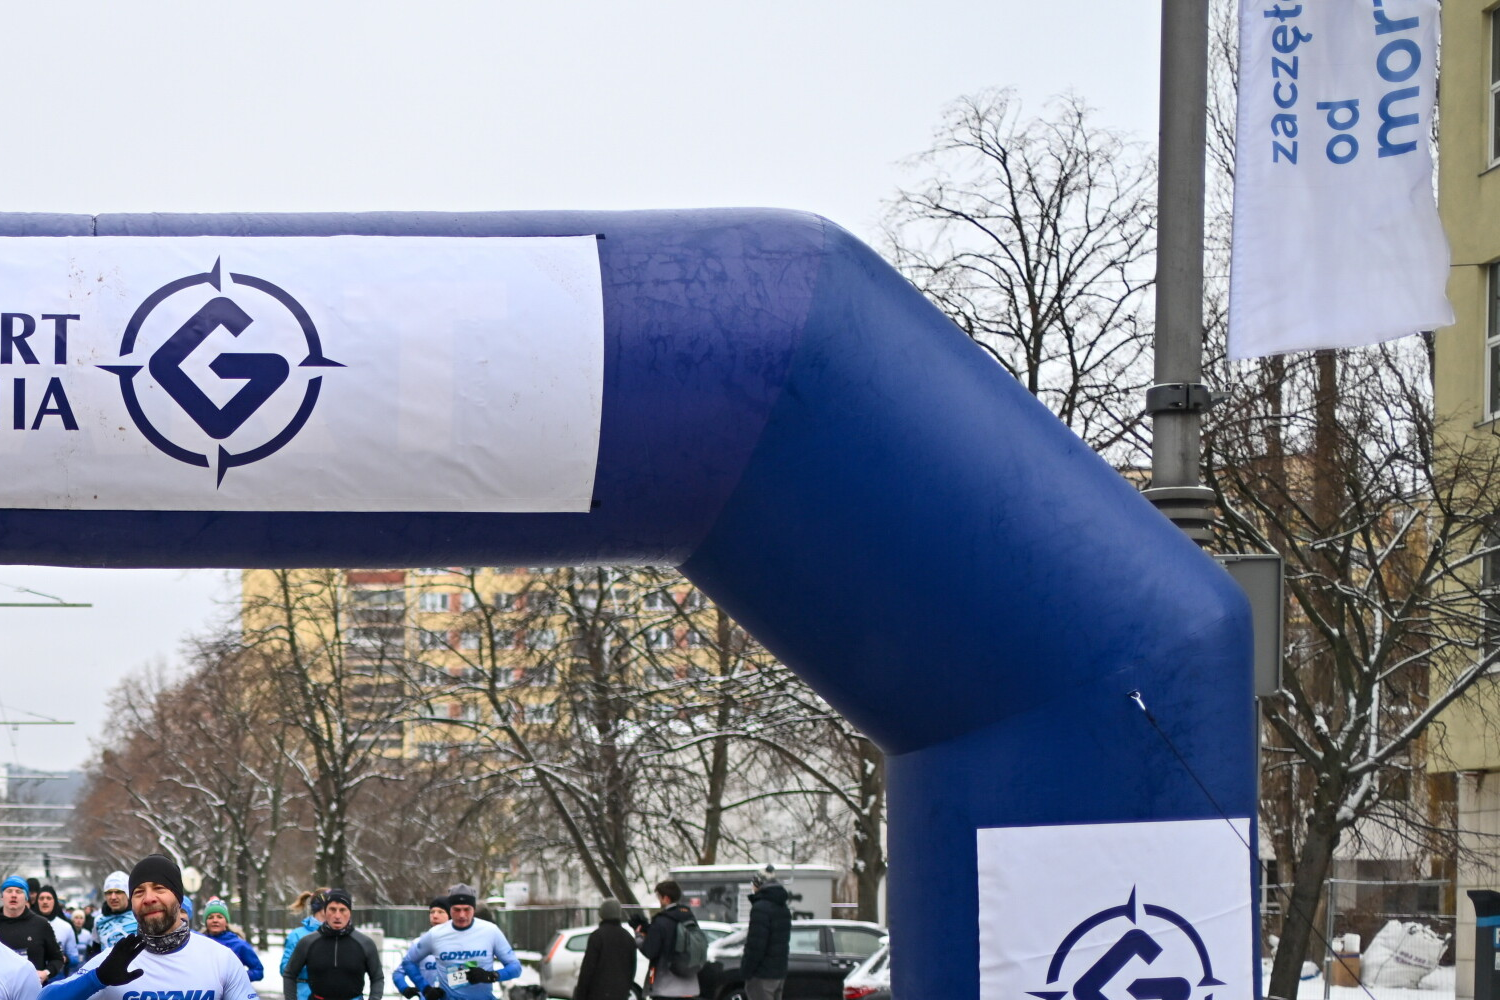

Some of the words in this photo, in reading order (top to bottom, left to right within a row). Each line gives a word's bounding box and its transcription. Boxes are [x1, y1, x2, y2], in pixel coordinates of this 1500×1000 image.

[1263, 0, 1313, 165] zaczęł
[1316, 99, 1360, 165] od
[1373, 0, 1422, 158] mor
[440, 950, 487, 961] GDYNIA
